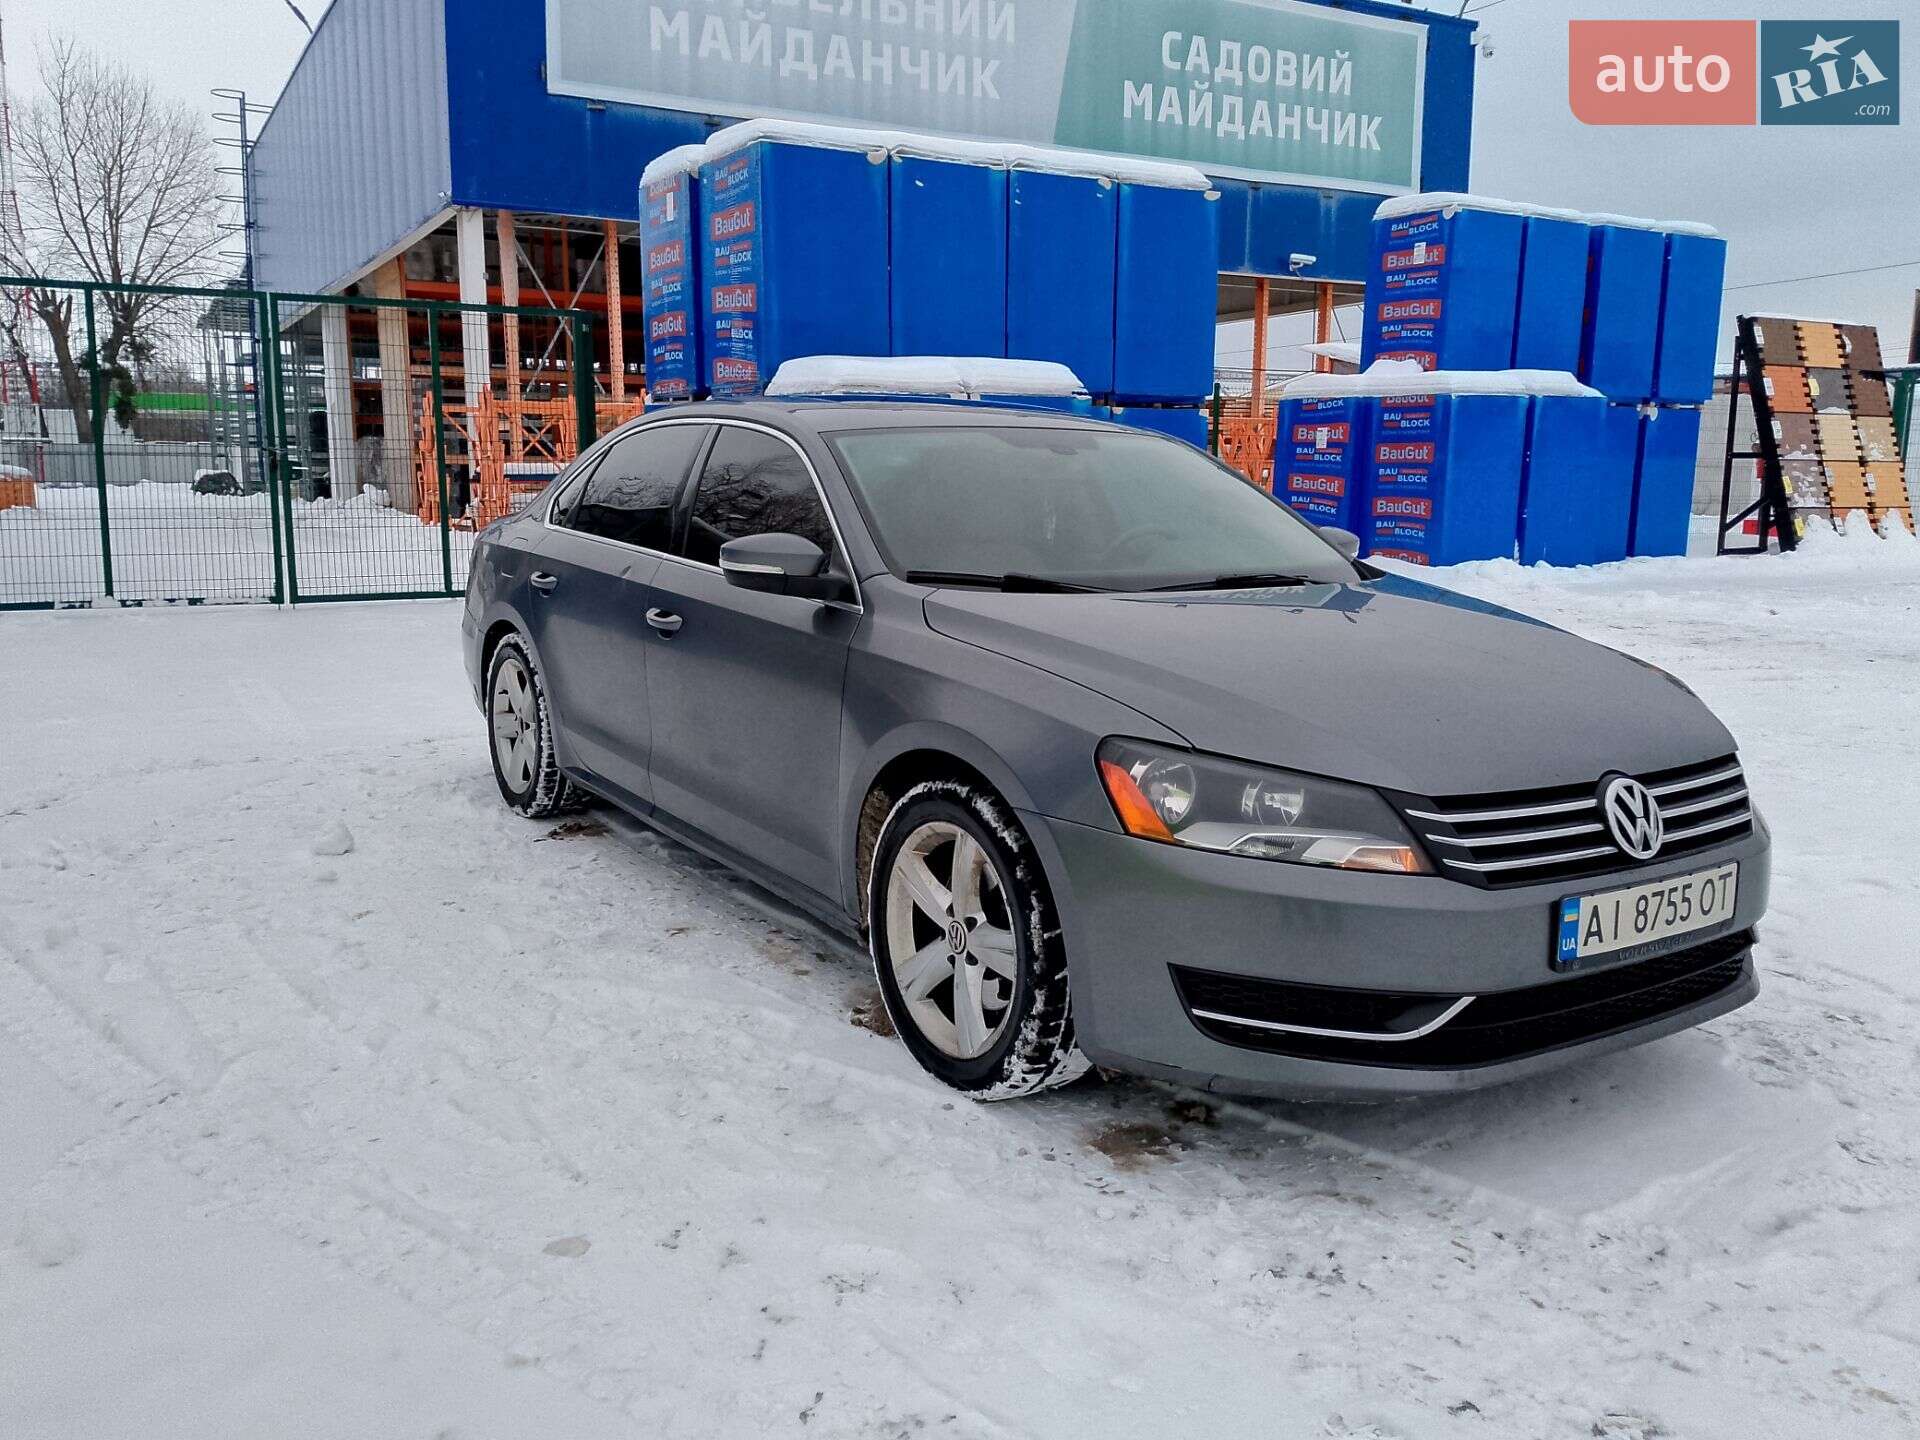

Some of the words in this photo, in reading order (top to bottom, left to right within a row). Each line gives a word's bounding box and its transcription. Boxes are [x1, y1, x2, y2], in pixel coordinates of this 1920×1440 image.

[649, 6, 1001, 100] МАЙДАНЧИК
[1161, 30, 1352, 96] САДОВИЙ
[1123, 79, 1383, 151] МАЙДАНЧИК
[715, 207, 752, 236] BauGut
[1391, 222, 1410, 232] BAU
[1408, 222, 1440, 235] BLOCK
[729, 250, 752, 264] BLOCK
[1387, 249, 1439, 268] Bauut
[1386, 273, 1406, 283] BAU
[1405, 277, 1438, 286] BLOCK
[716, 289, 753, 309] BauGut
[1383, 302, 1435, 318] BauGut
[652, 315, 683, 338] BauGut
[1382, 324, 1402, 333] BAU
[1400, 329, 1434, 337] BLOCK
[664, 351, 684, 361] BLOCK
[1317, 398, 1345, 410] BLOCK
[1383, 412, 1402, 421] BAU
[1400, 418, 1431, 428] BLOCK
[1314, 454, 1343, 462] BLOCK
[1380, 445, 1429, 460] BauGut
[1378, 467, 1398, 476] BAU
[1292, 476, 1340, 493] BauGut
[1397, 474, 1428, 483] BLOCK
[1291, 495, 1310, 503] BAU
[1309, 503, 1337, 515] BLOCK
[1376, 500, 1427, 515] BauGut
[1375, 520, 1396, 528] BAU
[1394, 527, 1425, 538] BLOCK
[1582, 899, 1621, 947] AI
[1633, 882, 1693, 934] 8755
[1699, 871, 1734, 916] OT
[1562, 938, 1576, 951] UA
